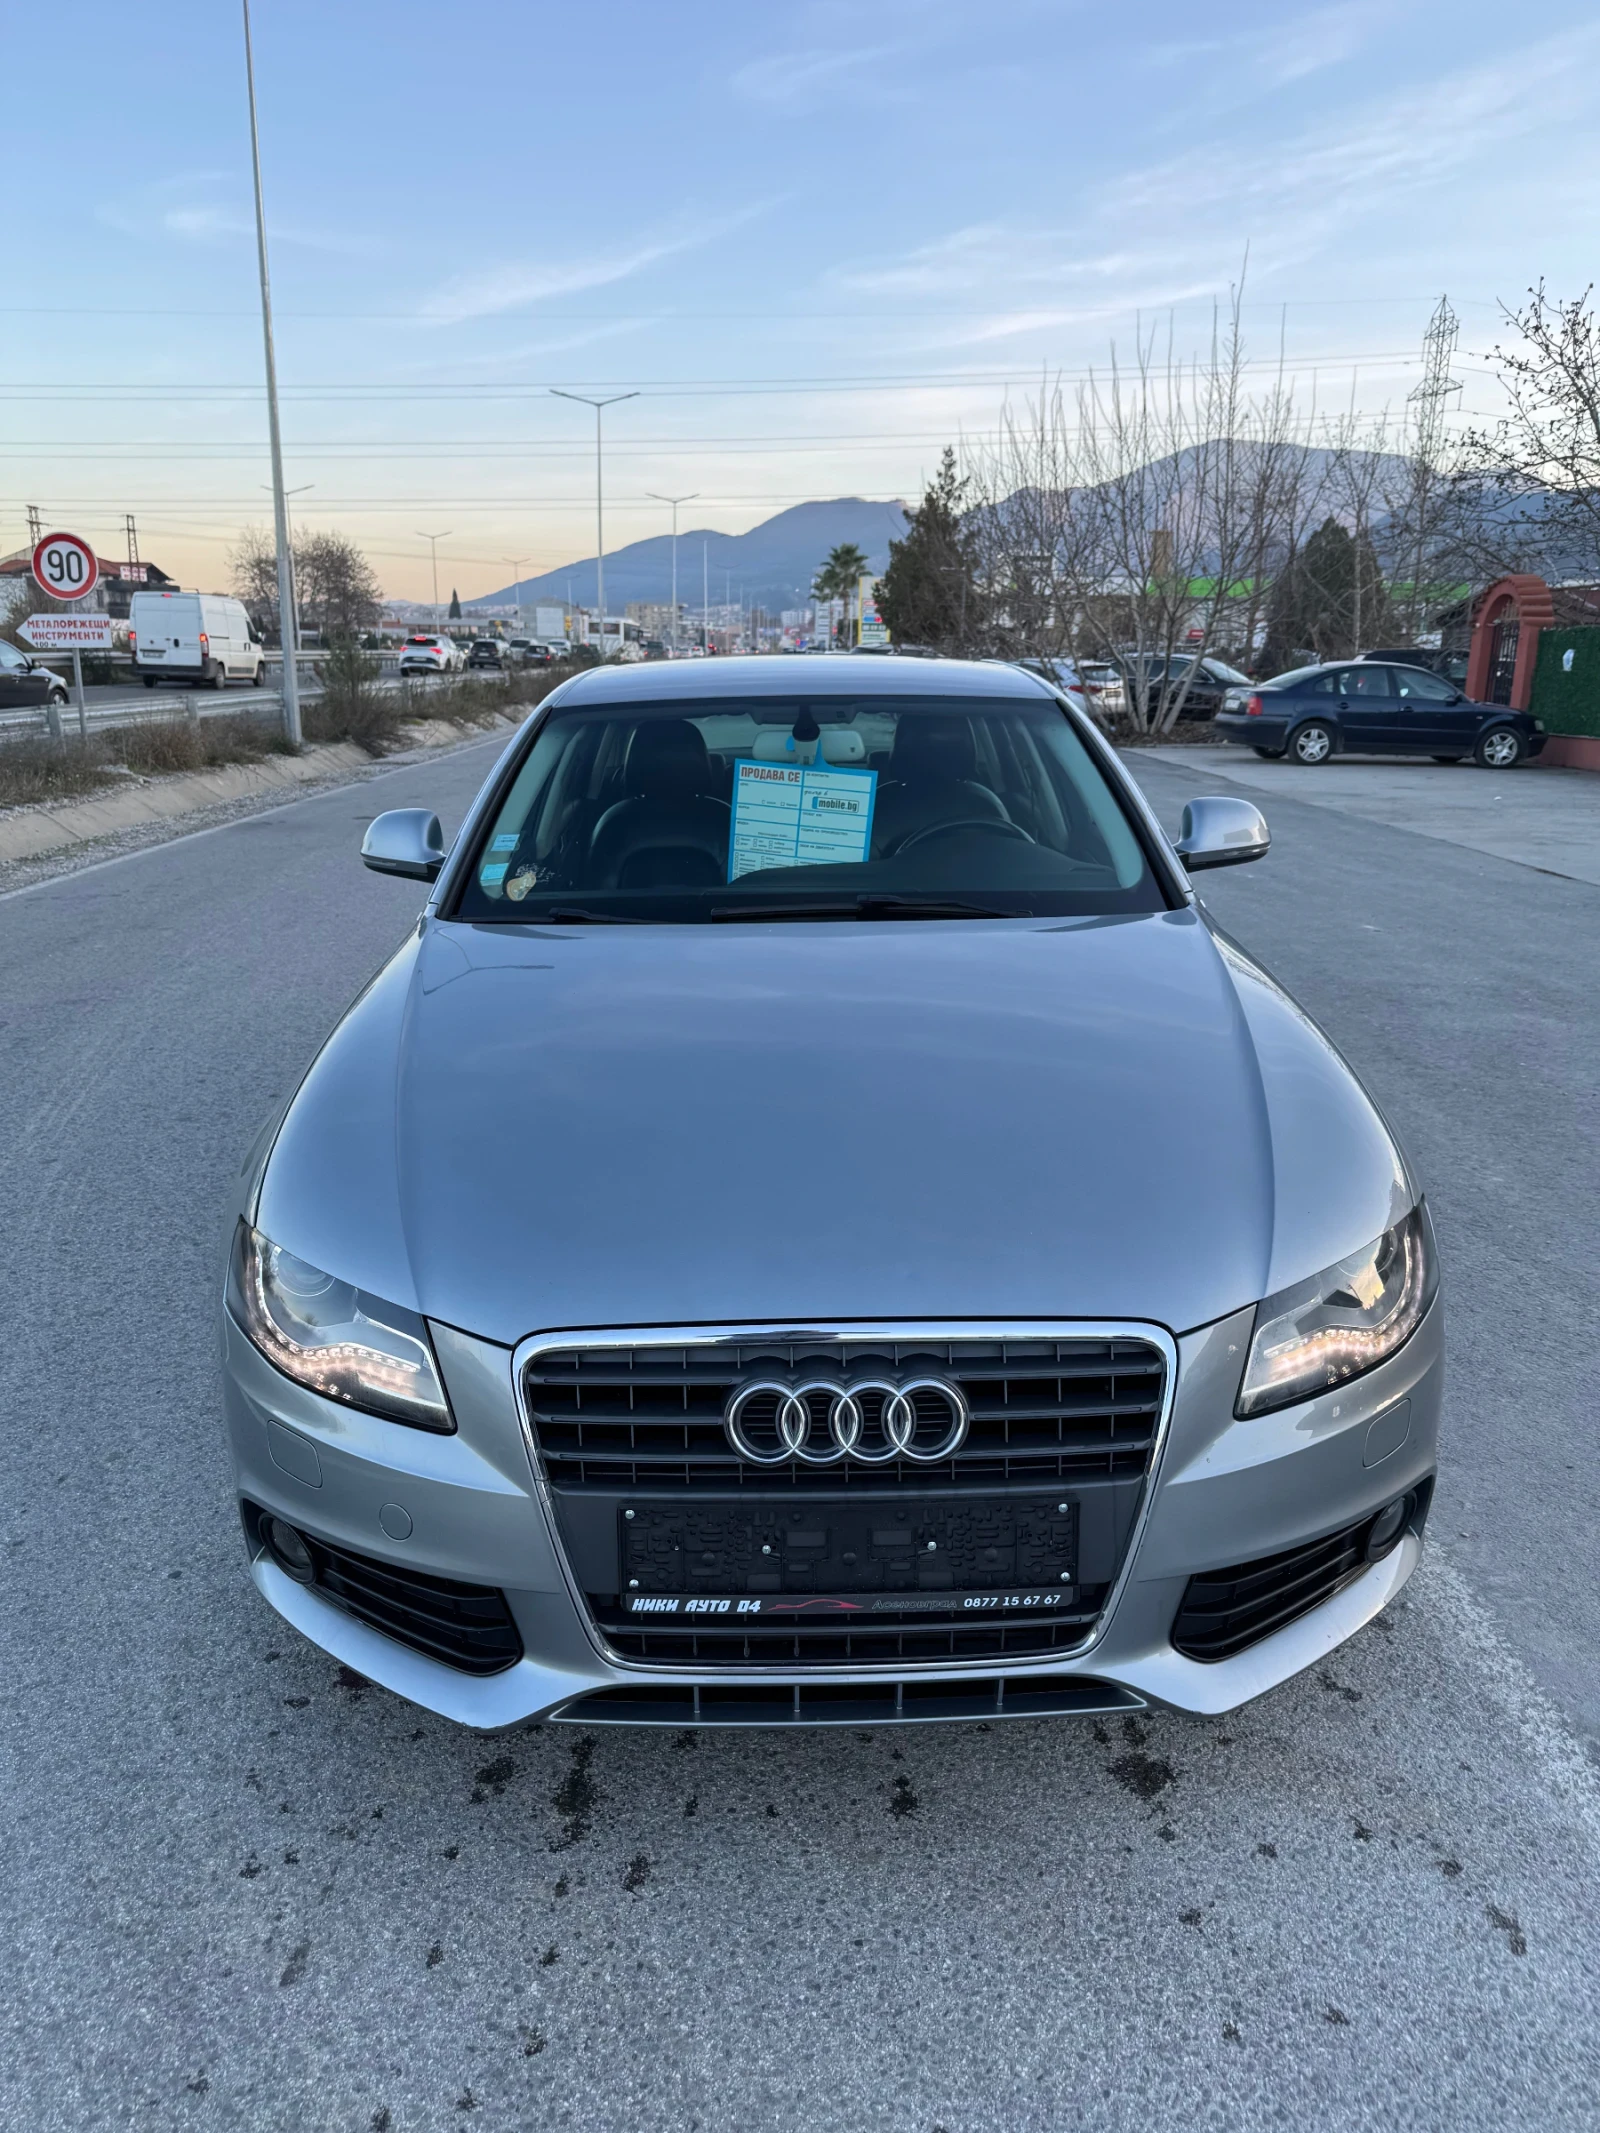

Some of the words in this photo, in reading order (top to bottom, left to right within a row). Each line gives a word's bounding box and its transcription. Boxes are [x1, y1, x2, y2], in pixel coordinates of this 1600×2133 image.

[47, 549, 83, 583] 90
[27, 620, 110, 629] МЕТАЛОРЕЖЕЩИ
[32, 631, 104, 640] ИНСТРУМЕНТИ
[741, 767, 785, 781] ПРОДАВА
[787, 771, 801, 783] СЕ
[818, 799, 858, 812] mobile.bg
[632, 1598, 679, 1612] НИКИ
[685, 1599, 731, 1612] АУТО
[736, 1600, 762, 1613] 04
[872, 1599, 958, 1611] Асеновград
[963, 1596, 998, 1608] 0877
[1003, 1595, 1020, 1606] 15
[1023, 1595, 1041, 1605] 67
[1043, 1594, 1061, 1604] 67
